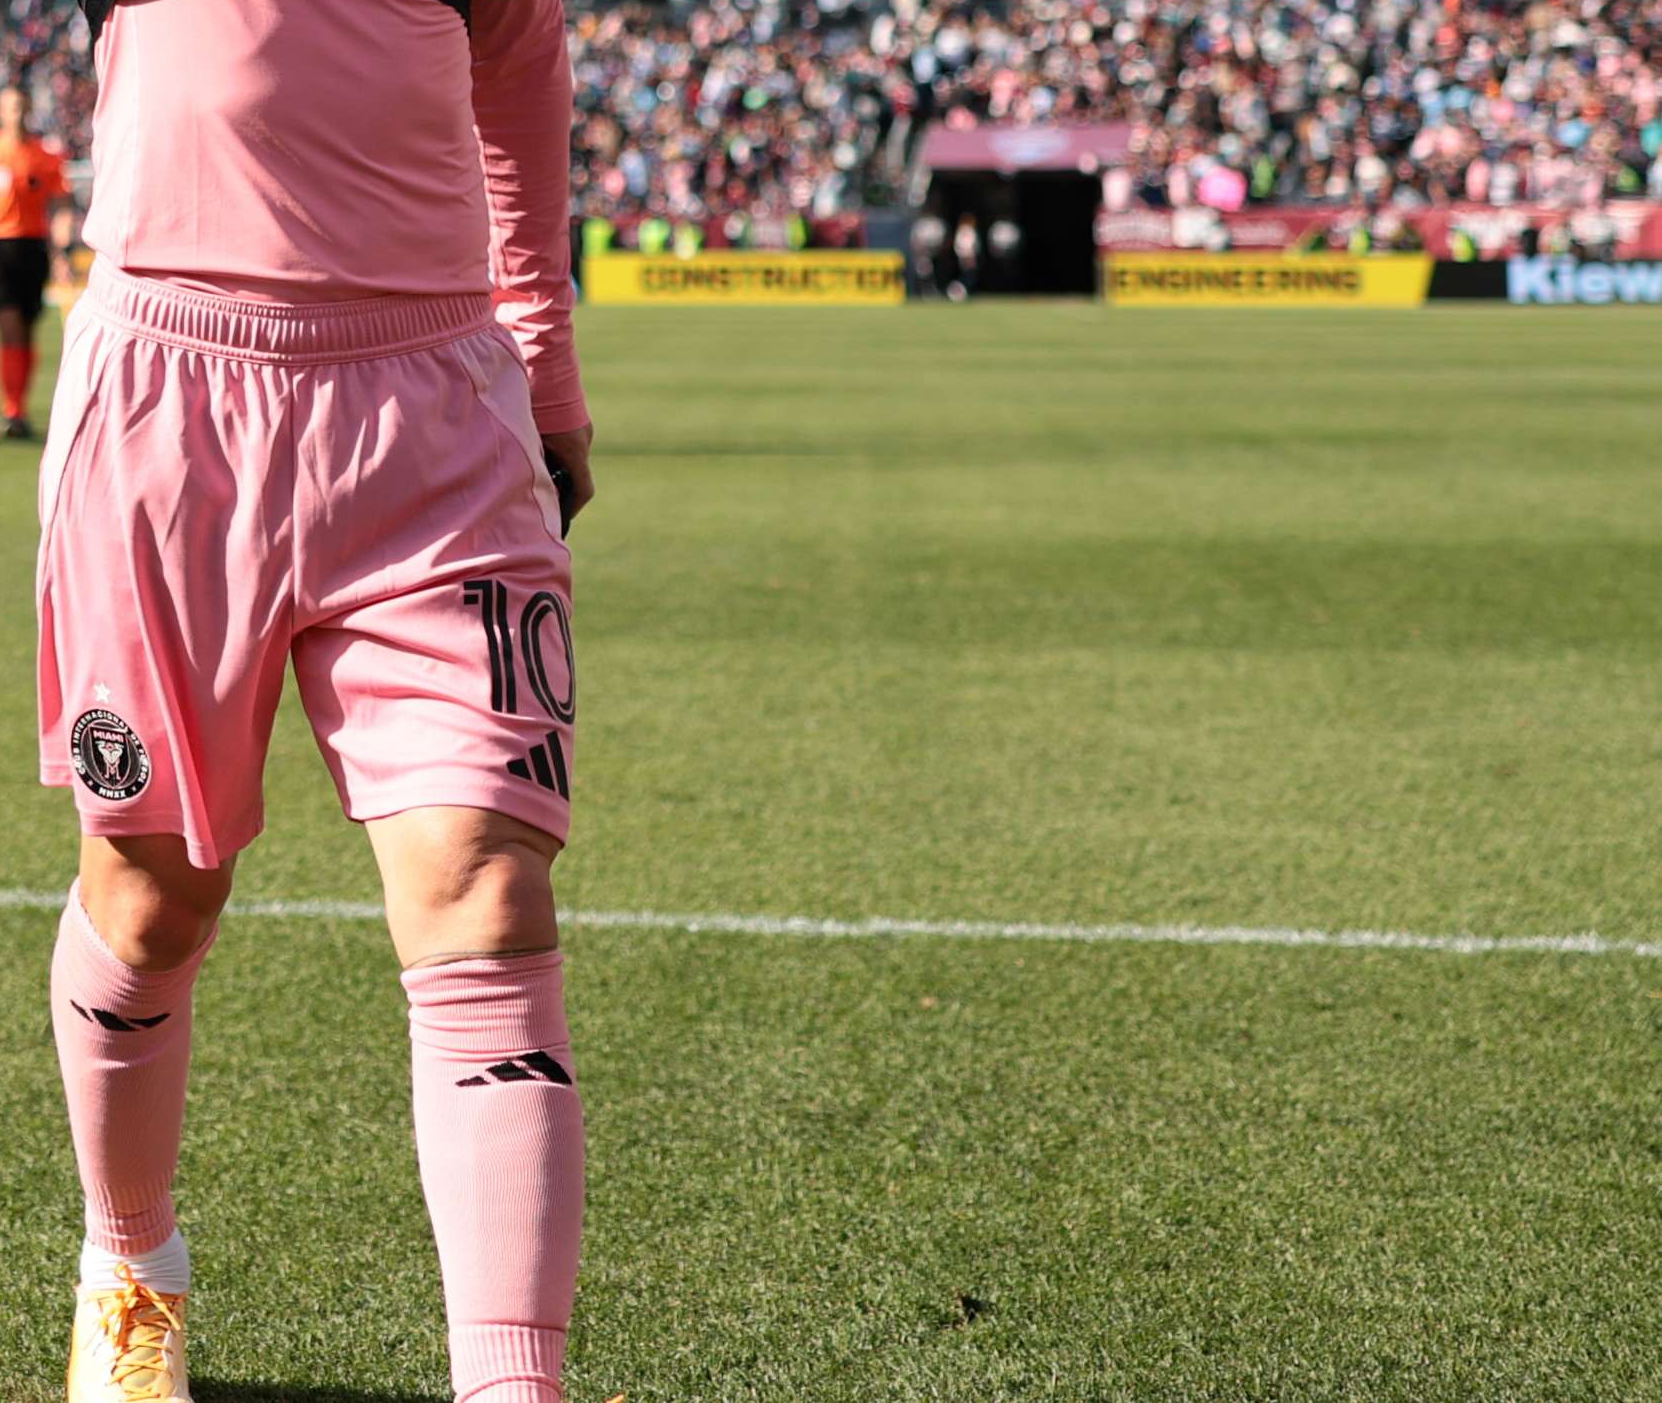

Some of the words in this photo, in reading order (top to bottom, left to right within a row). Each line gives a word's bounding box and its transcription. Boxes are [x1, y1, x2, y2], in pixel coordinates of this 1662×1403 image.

[642, 265, 904, 293] CONSTRUCTION
[1108, 268, 1360, 293] ENGINEERING
[463, 579, 575, 725] 10
[92, 729, 125, 743] MIAMI
[98, 785, 127, 799] MMXX
